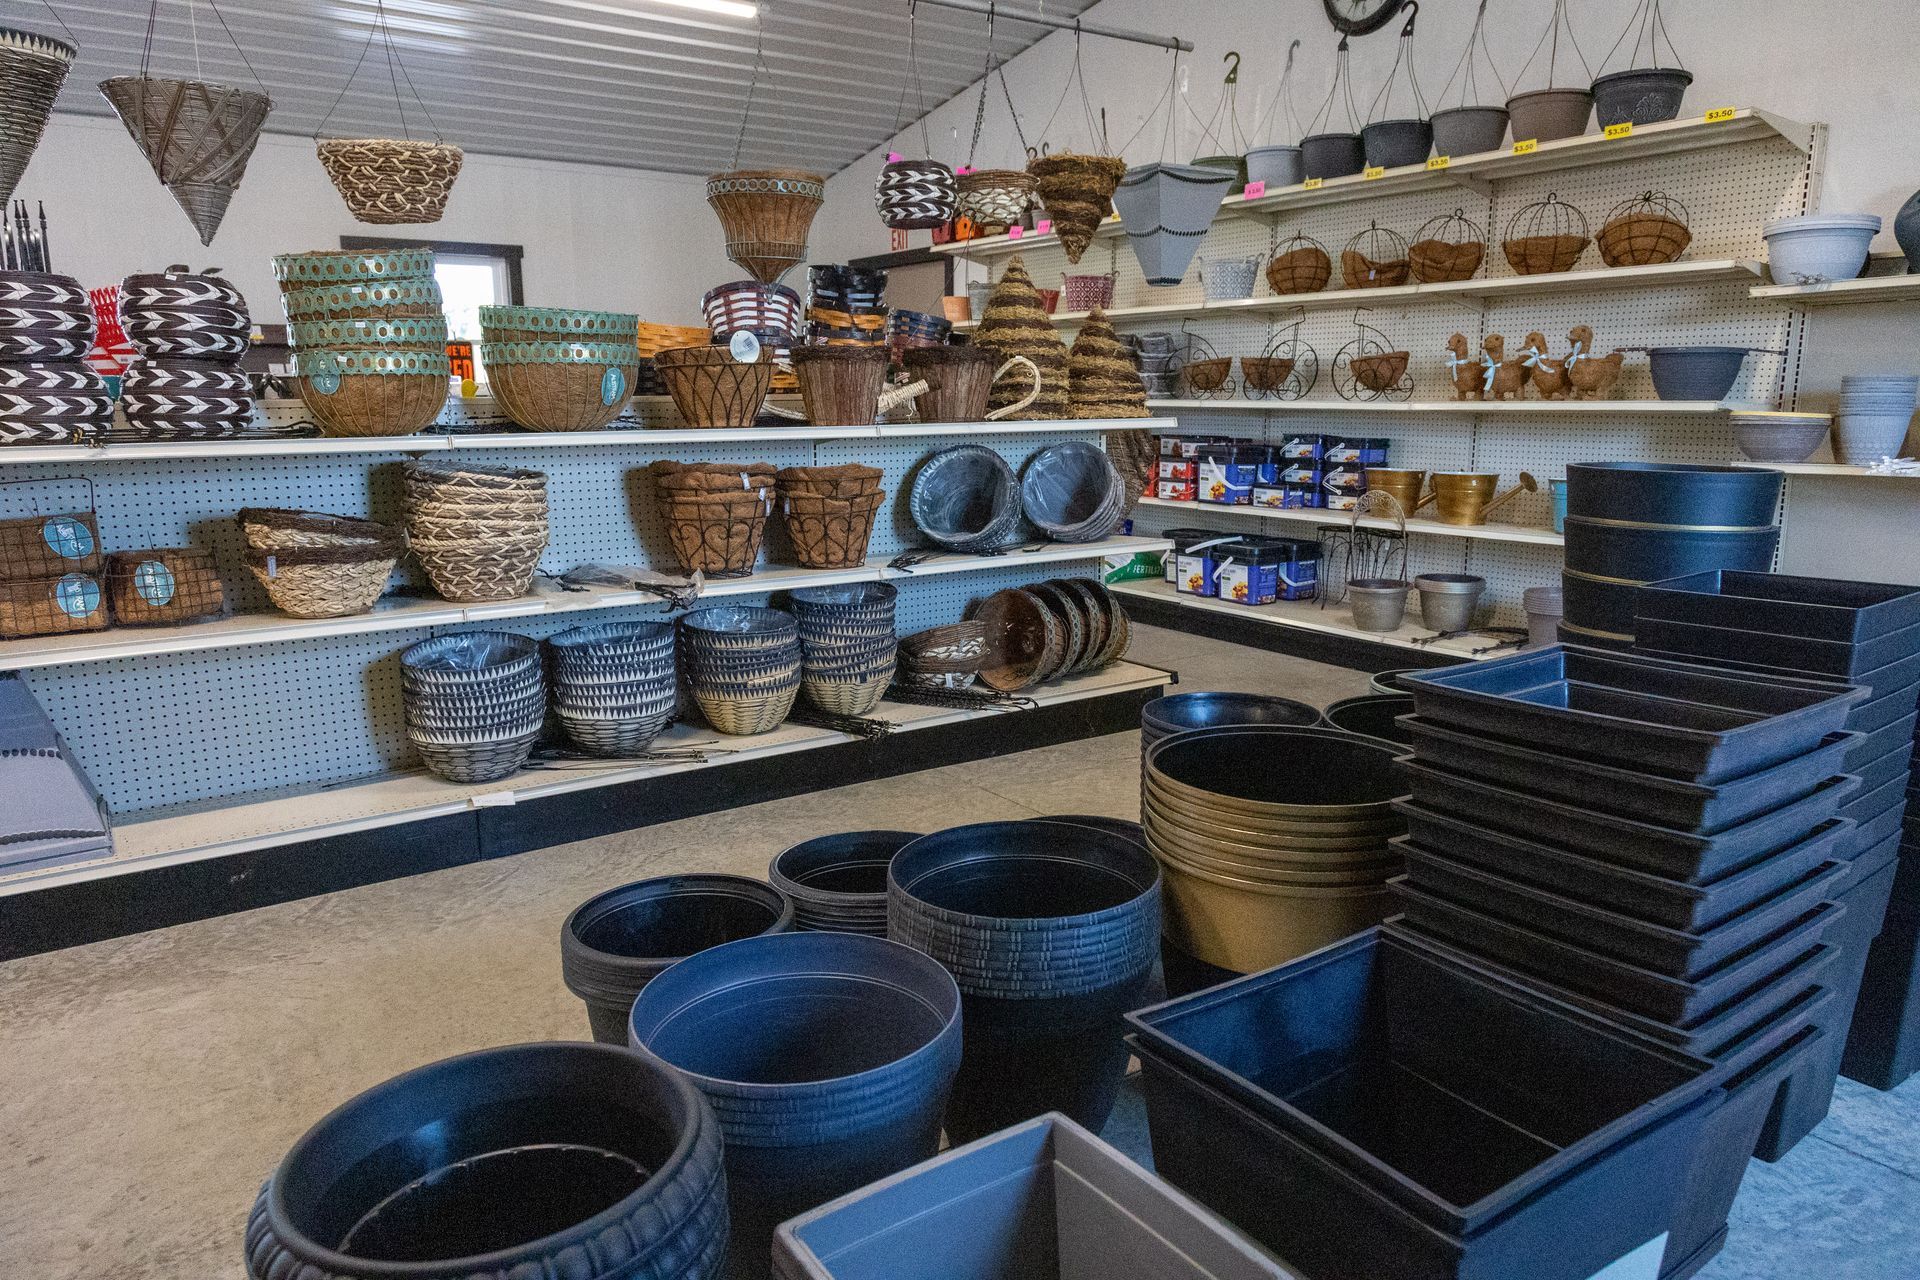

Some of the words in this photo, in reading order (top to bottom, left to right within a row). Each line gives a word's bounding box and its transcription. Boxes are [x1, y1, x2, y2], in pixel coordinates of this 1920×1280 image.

[1708, 109, 1733, 120] $3.50
[1607, 126, 1630, 137] $3.50
[1514, 143, 1534, 153] $3.50
[1430, 158, 1448, 168] $3.50
[891, 228, 908, 251] EXIT
